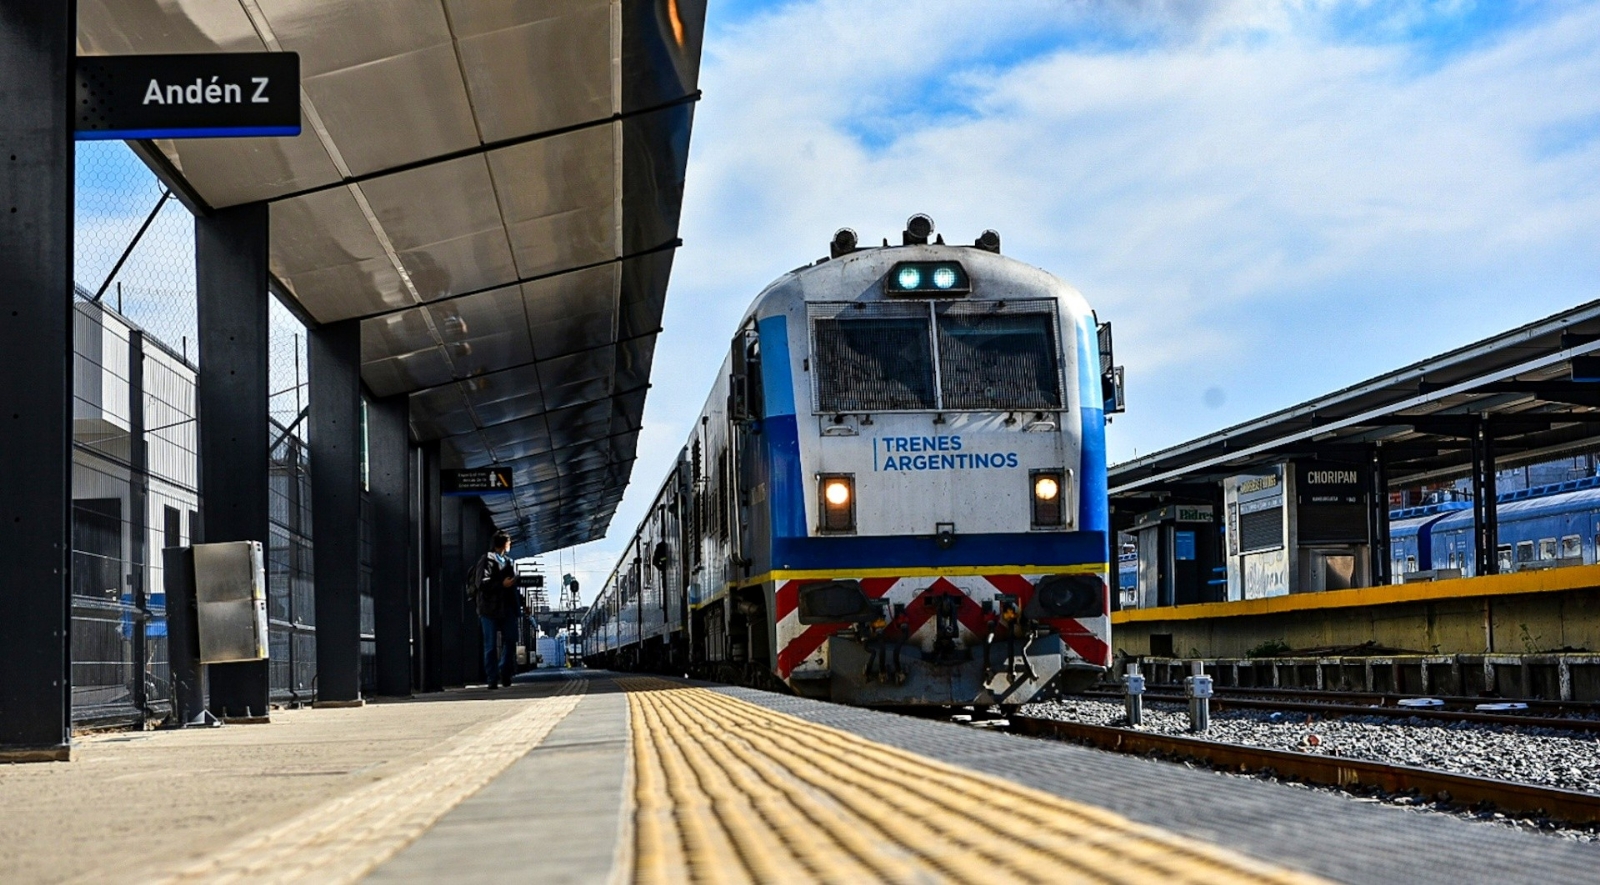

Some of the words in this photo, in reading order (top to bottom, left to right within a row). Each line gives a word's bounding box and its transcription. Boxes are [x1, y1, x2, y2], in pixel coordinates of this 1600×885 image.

[142, 76, 241, 105] Andén
[251, 77, 269, 103] Z
[882, 435, 962, 452] TRENES
[883, 452, 1018, 471] ARGENTINOS
[1307, 470, 1357, 484] CHORIPAN
